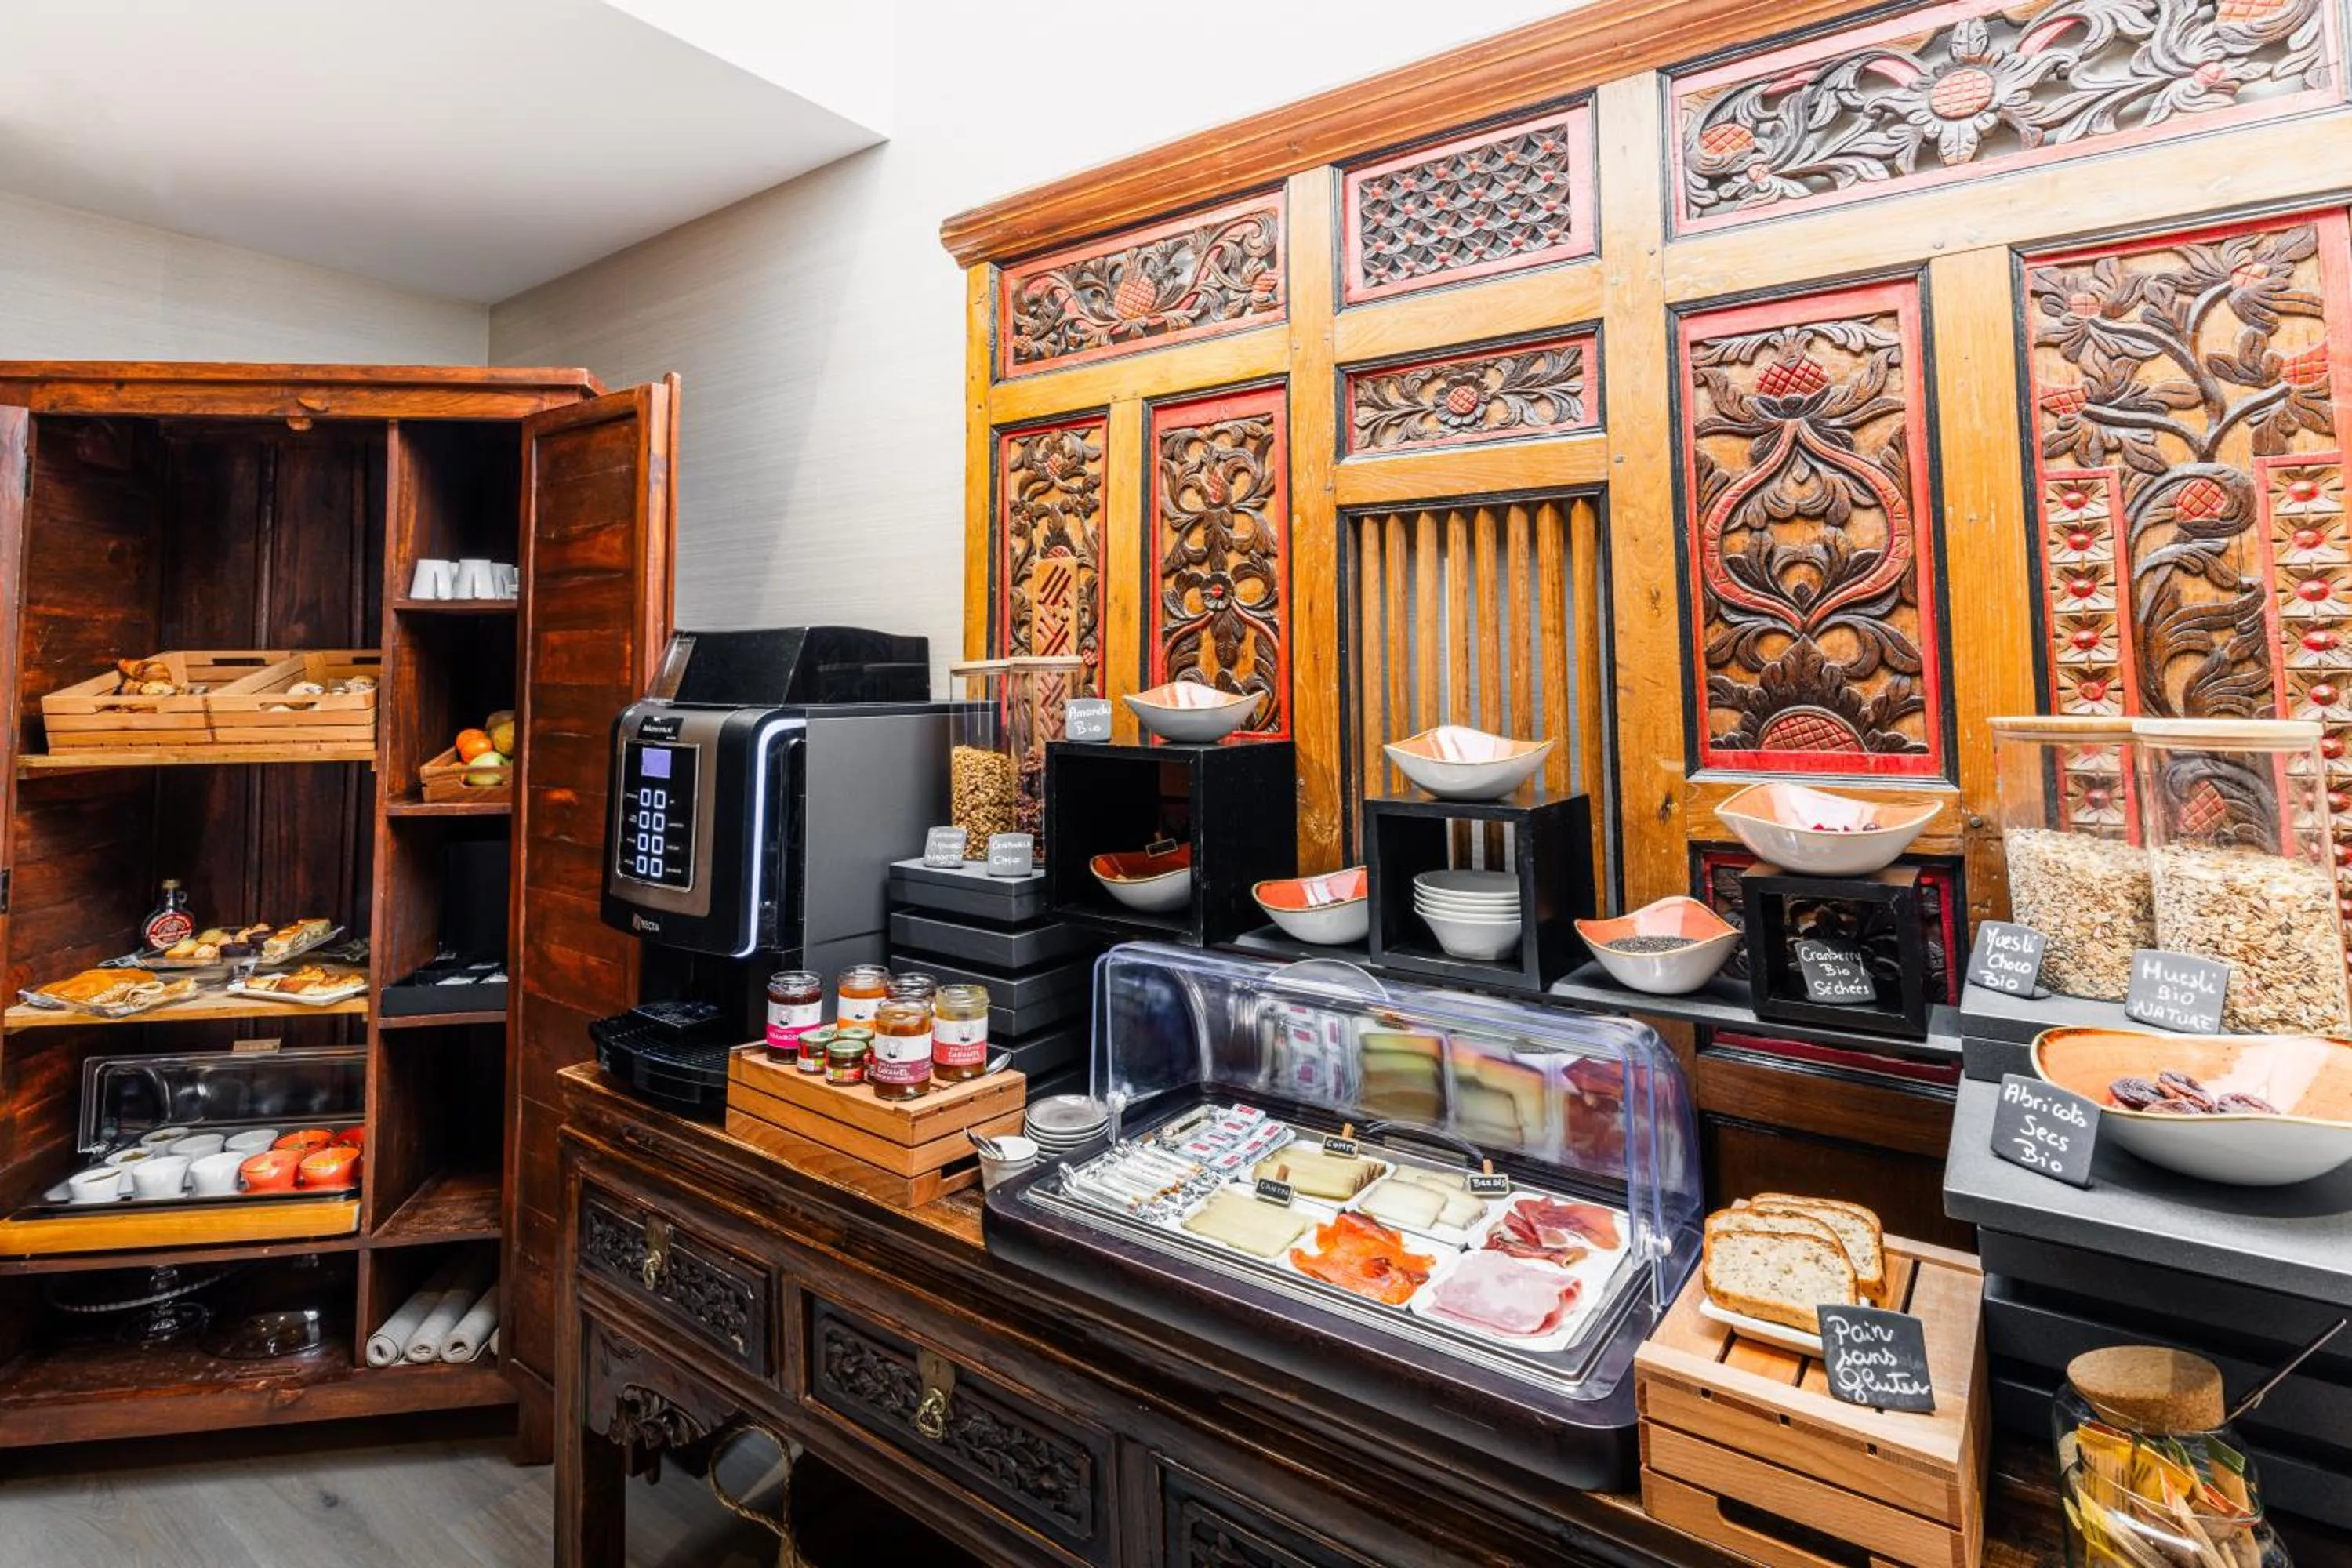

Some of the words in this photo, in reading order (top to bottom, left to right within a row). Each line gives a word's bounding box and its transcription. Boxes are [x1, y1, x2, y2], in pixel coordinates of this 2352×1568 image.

[1074, 720, 1102, 735] Bio
[1801, 946, 1865, 976] Cranberry
[1819, 963, 1851, 977] Bio
[1987, 953, 2033, 975] Choco
[2129, 1000, 2214, 1032] NATURE
[2004, 1083, 2087, 1127] Abricots
[2019, 1114, 2070, 1152] Secs
[2013, 1138, 2063, 1173] Bio
[1826, 1315, 1895, 1346] Pain
[1835, 1347, 1899, 1372] sans
